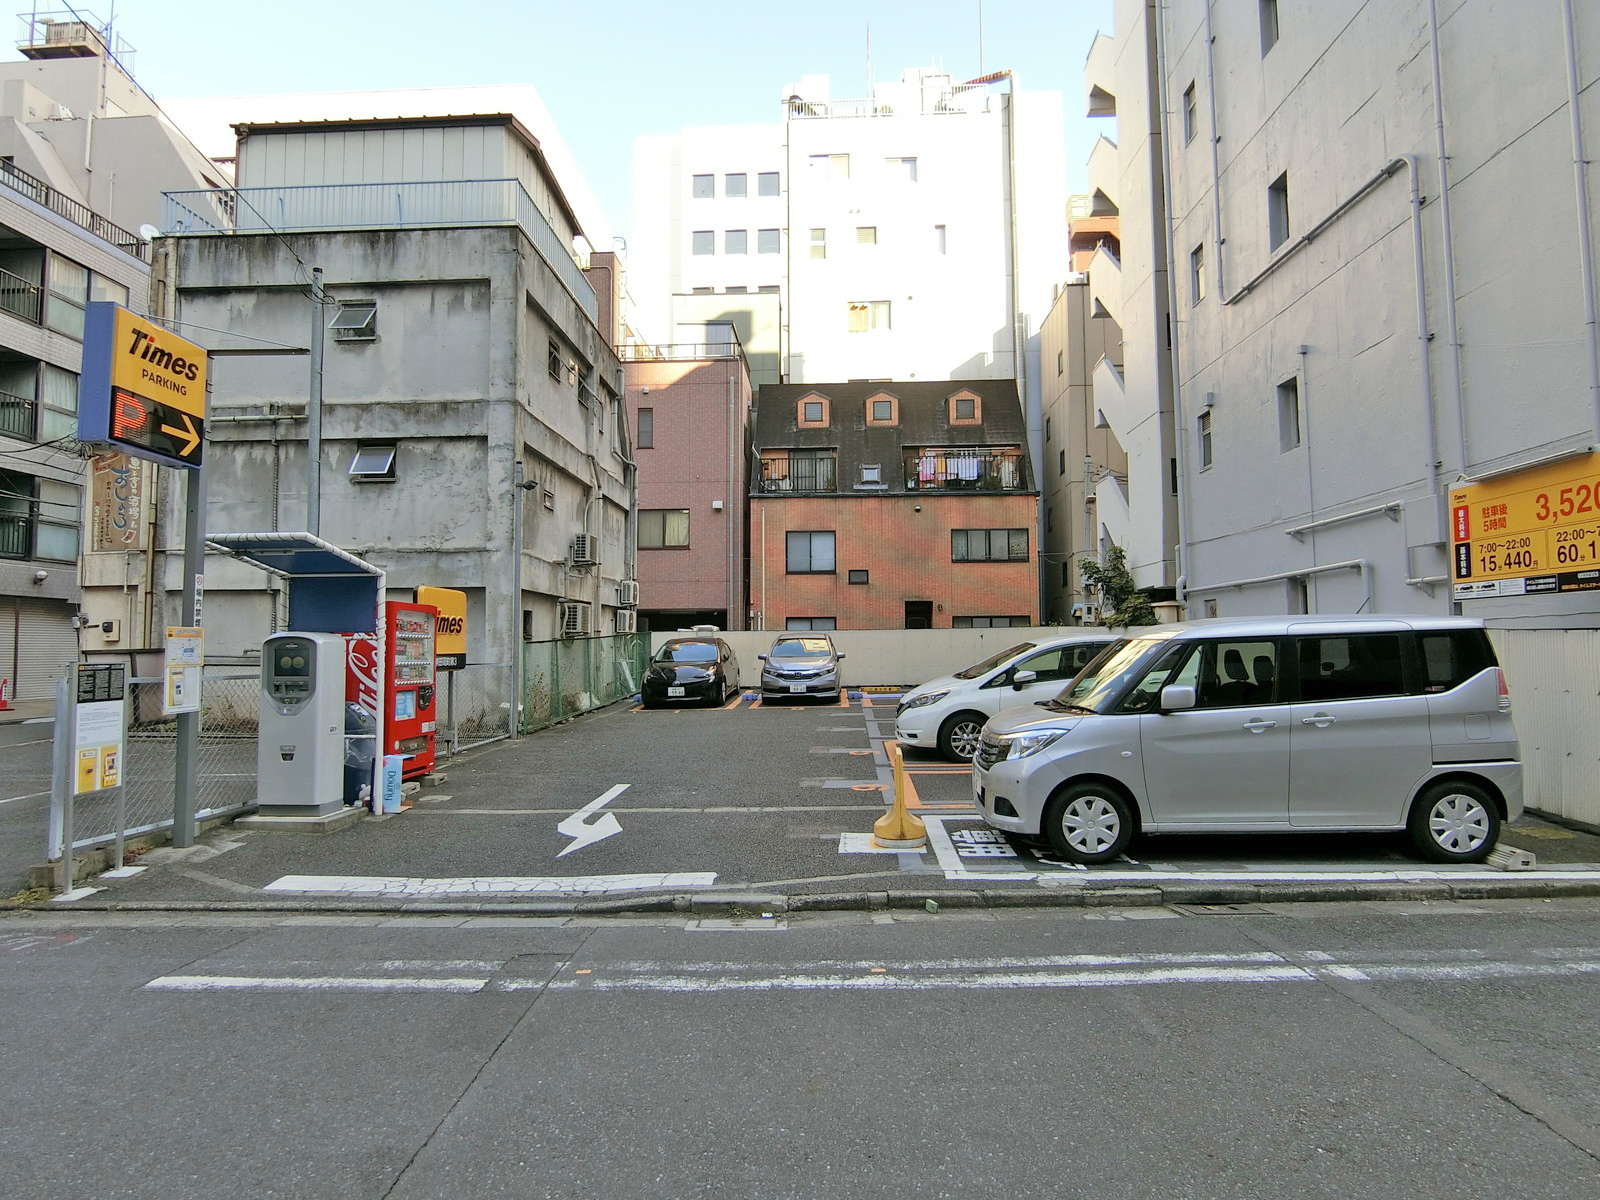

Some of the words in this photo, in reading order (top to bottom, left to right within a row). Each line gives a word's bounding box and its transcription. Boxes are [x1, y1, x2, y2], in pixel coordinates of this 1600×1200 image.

[128, 327, 200, 382] Times
[141, 368, 188, 397] PARKING
[113, 392, 146, 438] P
[1481, 503, 1508, 520] 駐車後
[1483, 517, 1507, 532] 5時間
[437, 610, 464, 634] imes
[384, 770, 397, 801] Downy
